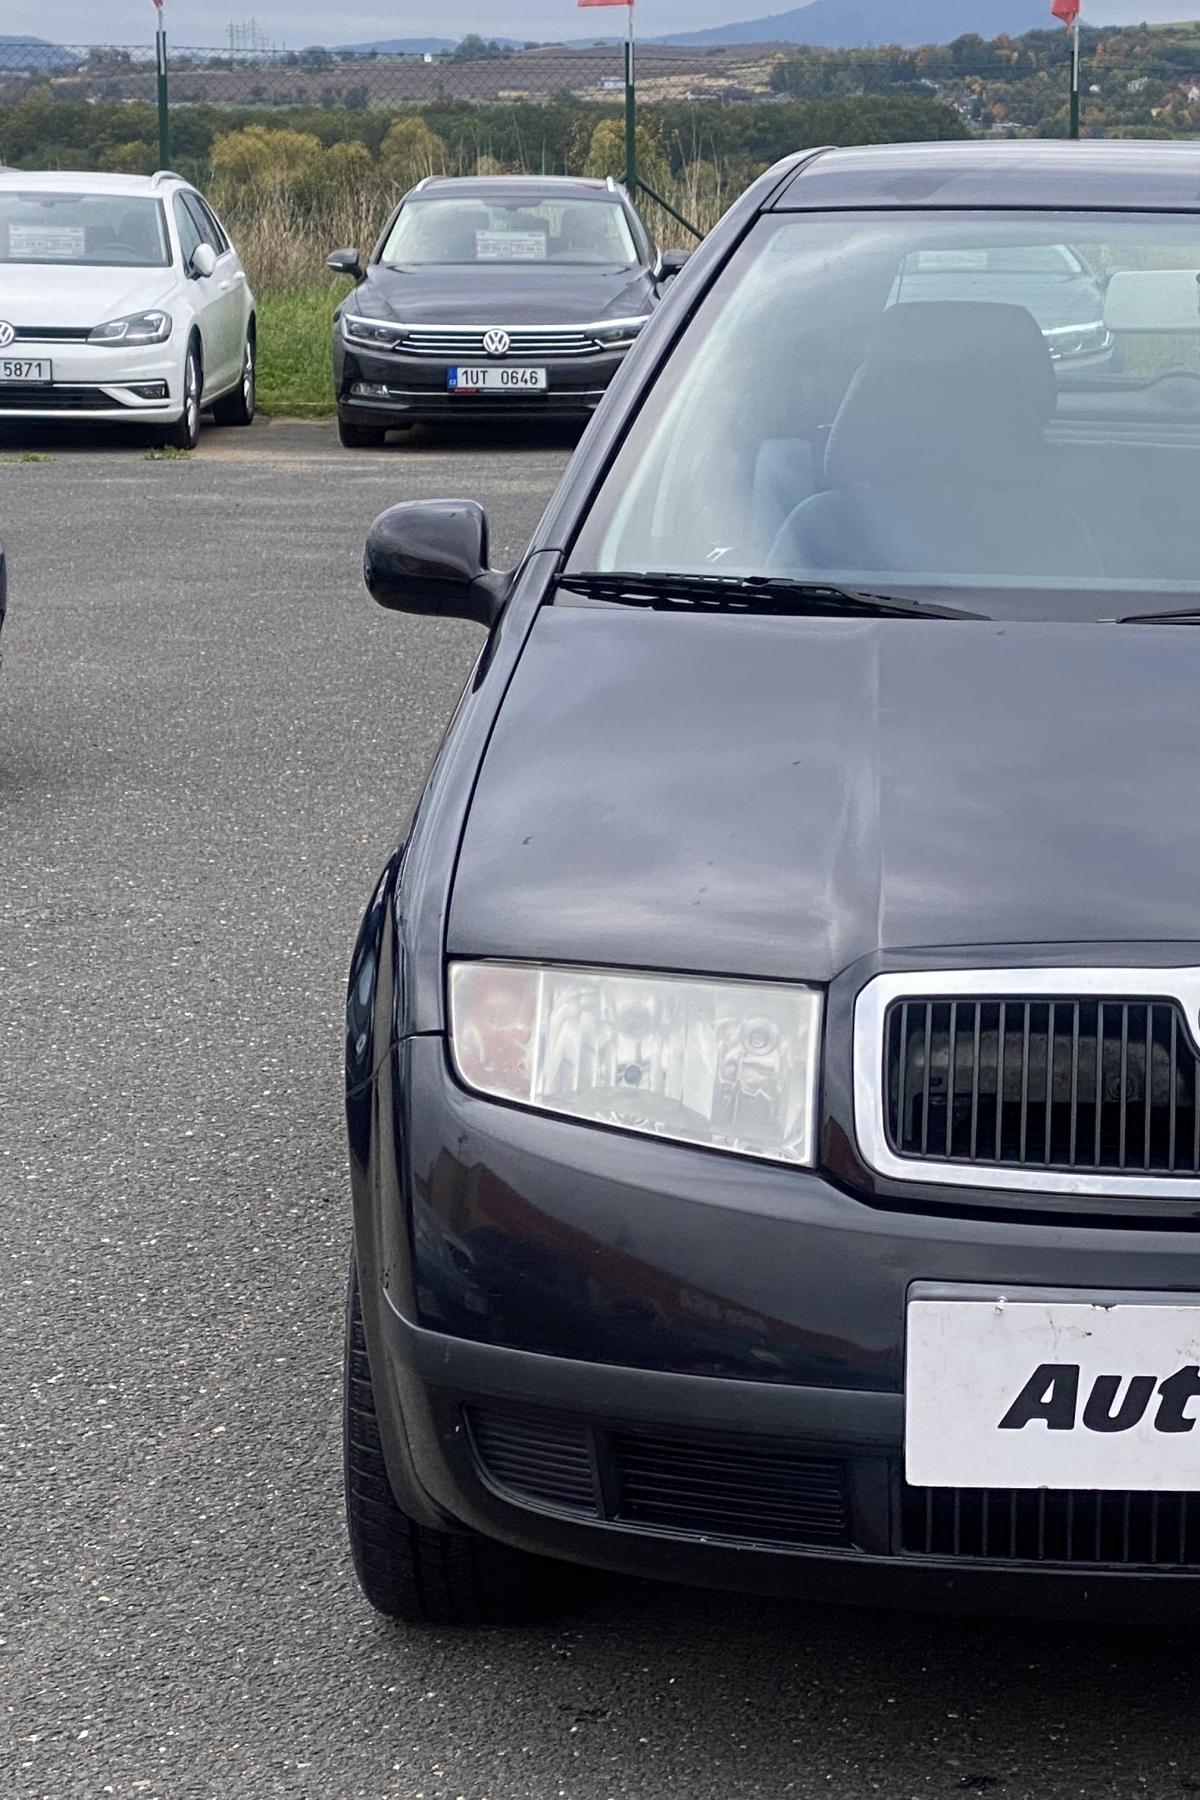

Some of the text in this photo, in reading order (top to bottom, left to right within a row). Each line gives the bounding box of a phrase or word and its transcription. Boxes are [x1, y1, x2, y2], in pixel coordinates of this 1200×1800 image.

[3, 362, 42, 378] 5871
[462, 370, 488, 385] 1UT
[501, 370, 538, 385] 0646
